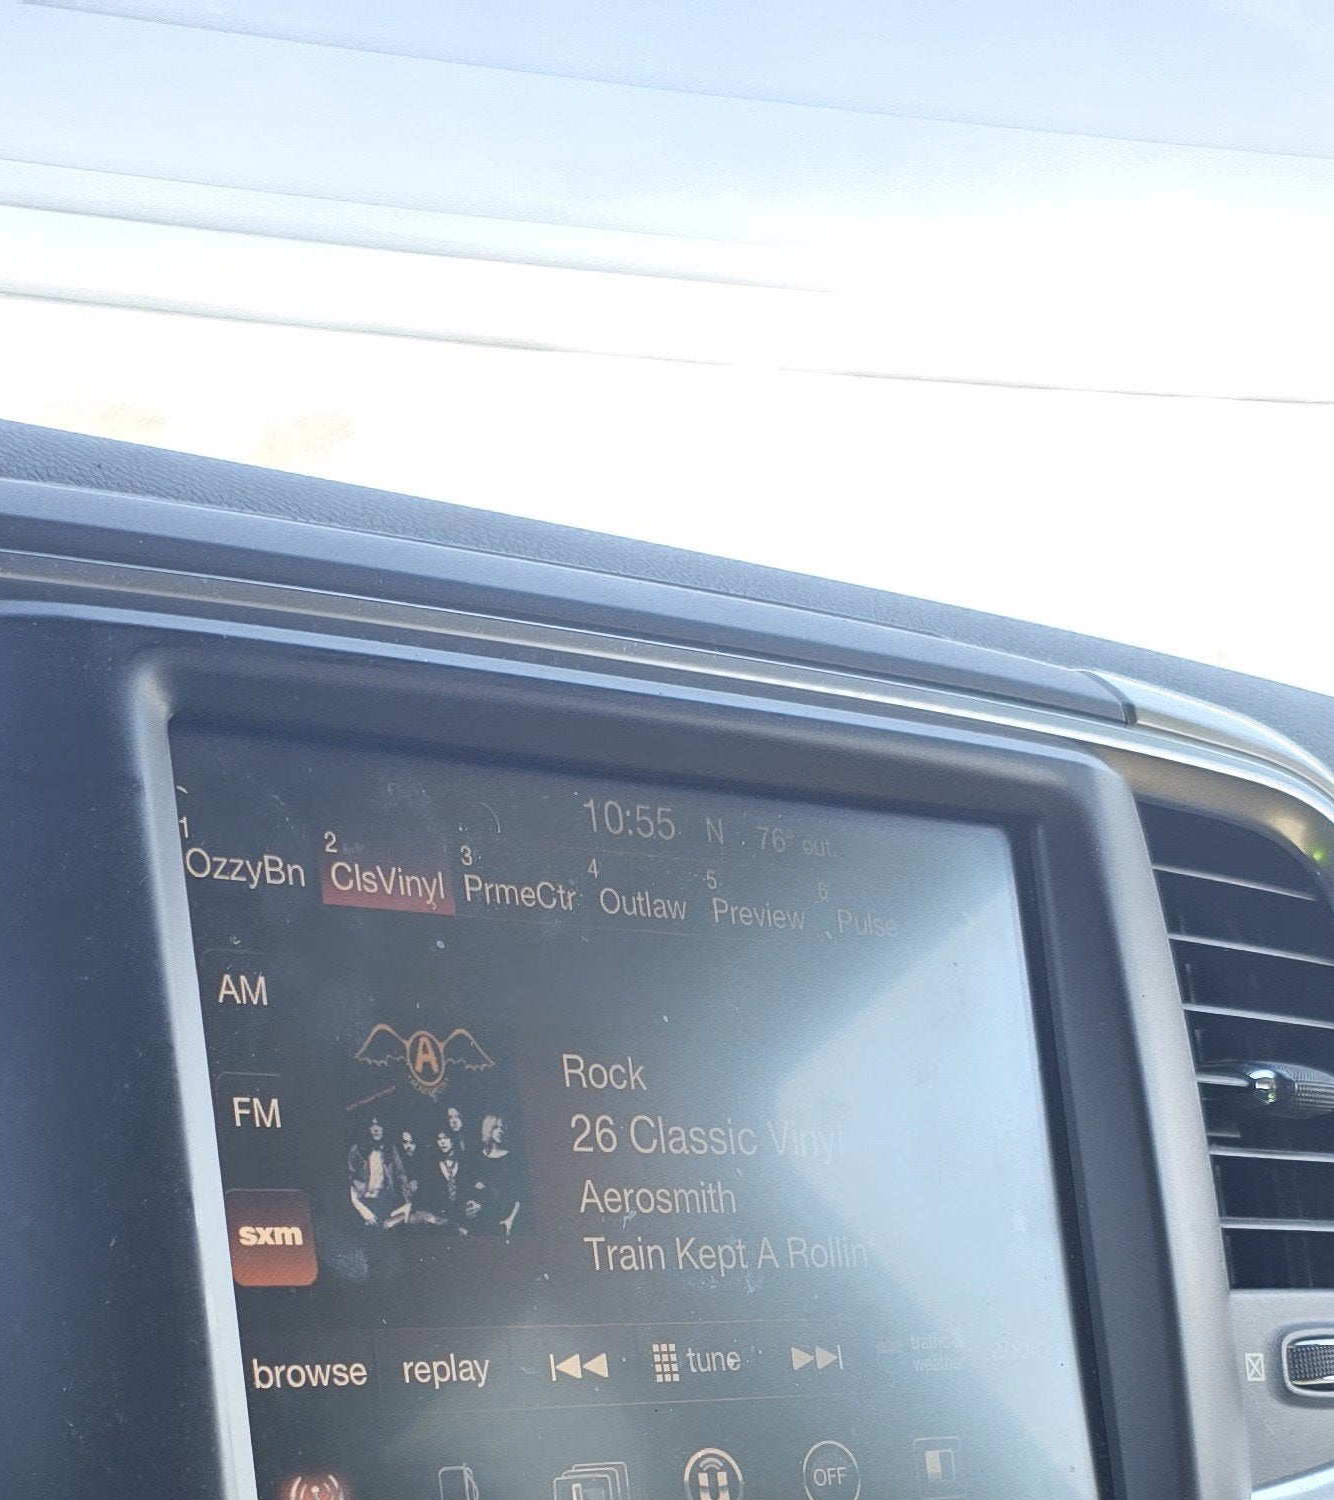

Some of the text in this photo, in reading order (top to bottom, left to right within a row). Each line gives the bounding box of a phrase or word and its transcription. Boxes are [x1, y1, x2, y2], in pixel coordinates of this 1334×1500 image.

[583, 799, 676, 842] 10:55
[707, 818, 725, 845] N
[323, 831, 339, 854] 2
[460, 845, 474, 867] 3
[184, 847, 307, 889] OzzyBn
[329, 861, 447, 909] ClsVinyl
[587, 857, 601, 880] 4
[705, 870, 718, 891] 5
[464, 873, 577, 912] PrmeCtr
[599, 887, 688, 921] Outlaw
[712, 896, 807, 932] Preview
[836, 908, 899, 939] Pulse
[217, 973, 269, 1007] AM
[562, 1053, 648, 1092] Rock
[232, 1096, 283, 1129] FM
[570, 1113, 845, 1167] 26 Classic Vinyl
[579, 1179, 737, 1216] Aerosmith
[238, 1224, 304, 1247] sxm
[584, 1236, 665, 1272] Train
[675, 1236, 747, 1278] Kept
[756, 1238, 781, 1269] A
[252, 1358, 368, 1389] browse
[402, 1353, 490, 1389] replay
[685, 1343, 742, 1374] tune
[812, 1466, 847, 1487] OFF
